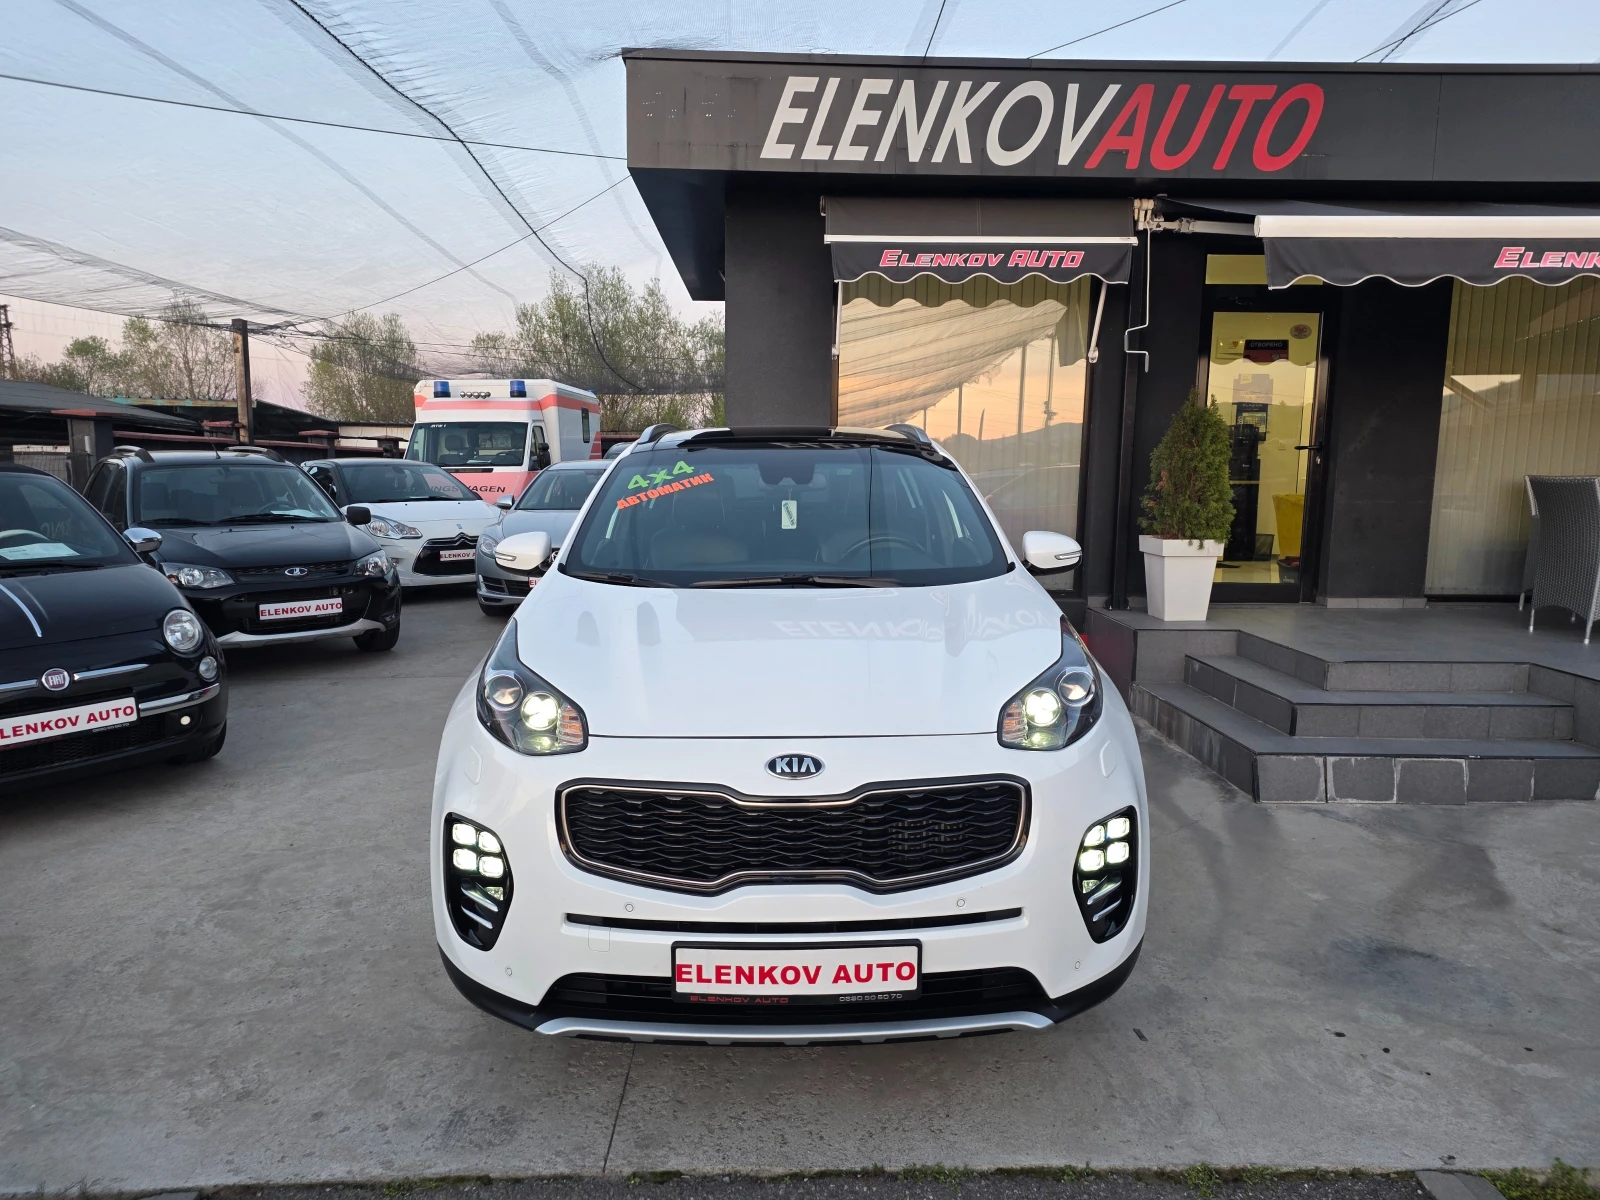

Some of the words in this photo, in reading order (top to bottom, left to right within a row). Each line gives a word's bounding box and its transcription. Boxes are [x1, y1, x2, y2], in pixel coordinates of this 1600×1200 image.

[1008, 249, 1085, 267] AUTO
[616, 473, 715, 510] АВТОМАТИК
[260, 605, 312, 617] ELENKOV
[314, 602, 343, 612] AUTO
[48, 673, 65, 686] FIAT
[86, 705, 135, 725] AUTO
[775, 757, 817, 773] KIA
[675, 963, 823, 986] ELENKOV
[831, 961, 916, 984] AUTO
[689, 995, 750, 1004] ELENKOV
[754, 996, 789, 1004] AUTO
